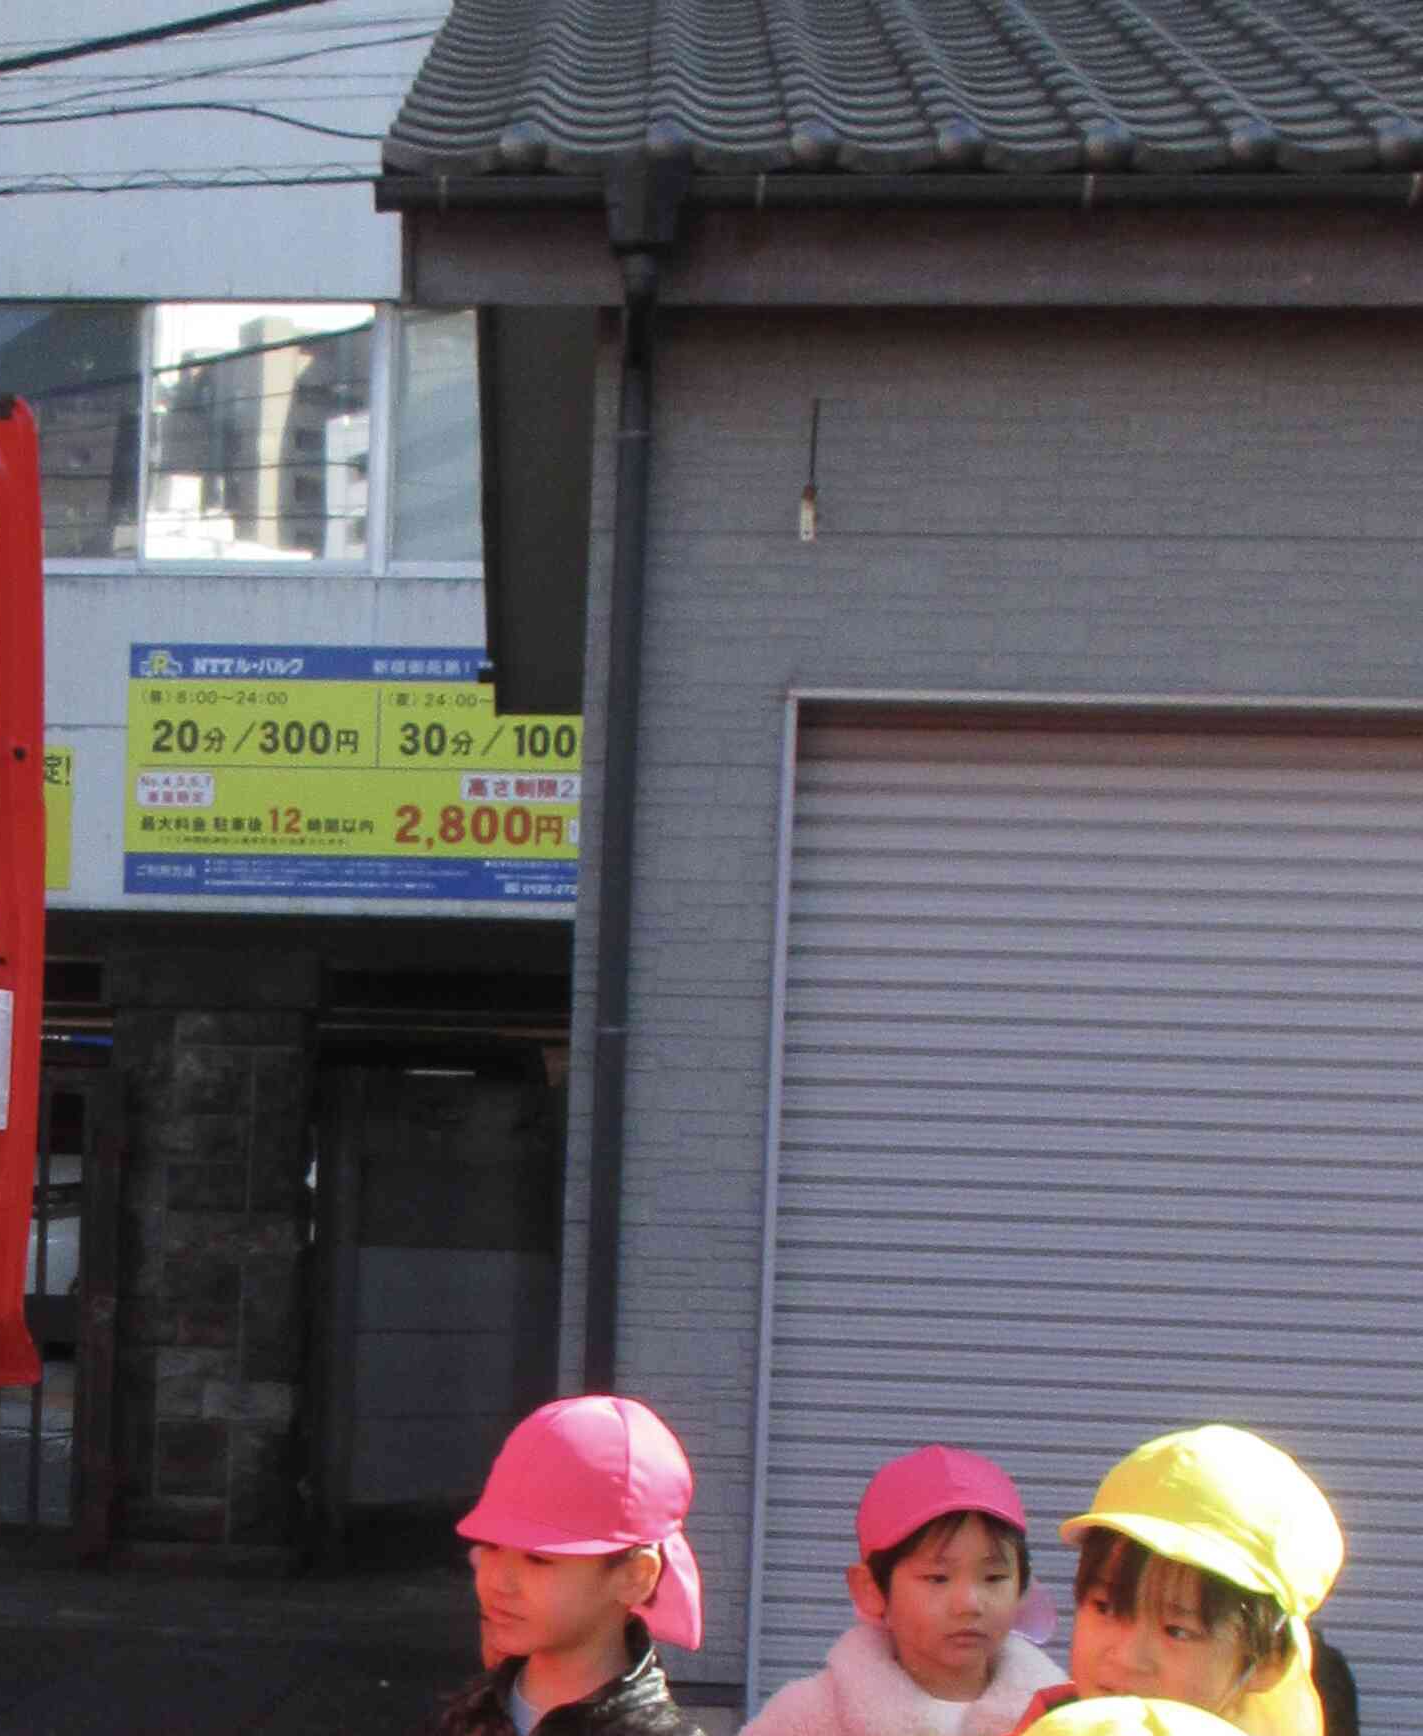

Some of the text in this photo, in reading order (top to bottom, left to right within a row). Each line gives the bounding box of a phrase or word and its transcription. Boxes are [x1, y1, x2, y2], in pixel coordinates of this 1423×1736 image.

[152, 719, 359, 755] 20分/300円
[399, 722, 576, 758] 30分/100
[467, 777, 575, 798] 高さ制限2
[395, 805, 562, 851] 2,800円
